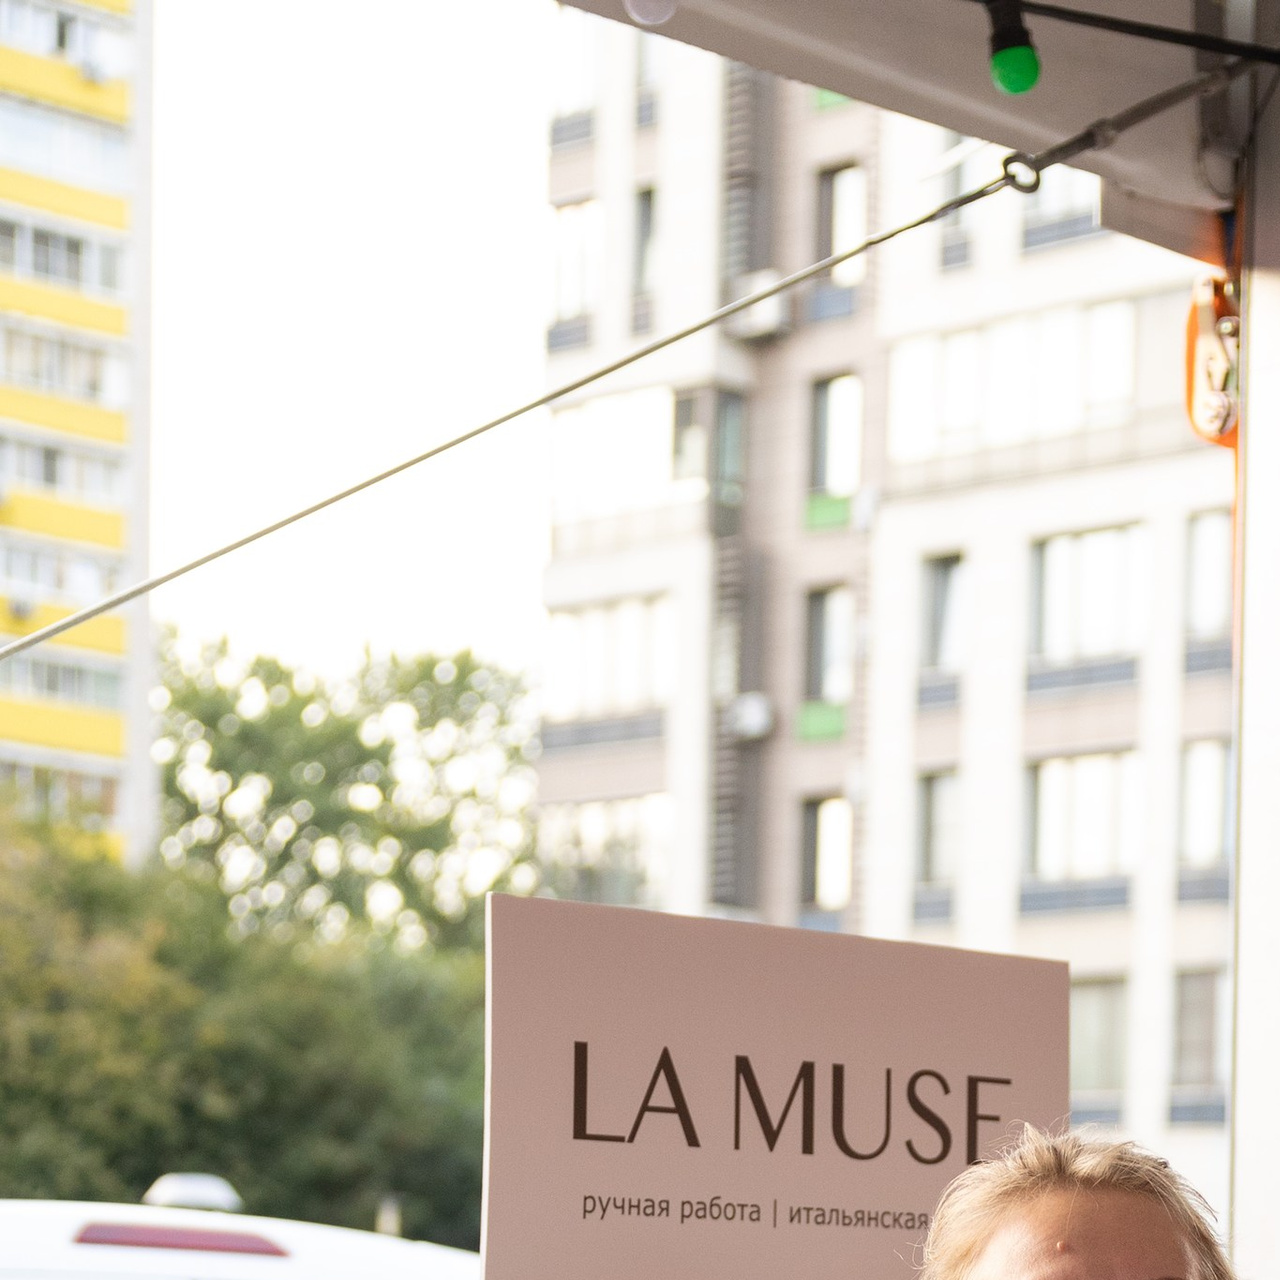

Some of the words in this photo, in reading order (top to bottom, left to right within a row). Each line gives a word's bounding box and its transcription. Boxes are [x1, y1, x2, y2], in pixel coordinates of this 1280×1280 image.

[573, 1041, 701, 1148] LA
[734, 1055, 1012, 1166] MUSE
[582, 1193, 670, 1219] ручная
[680, 1196, 761, 1224] работа
[789, 1202, 930, 1231] итальянская
